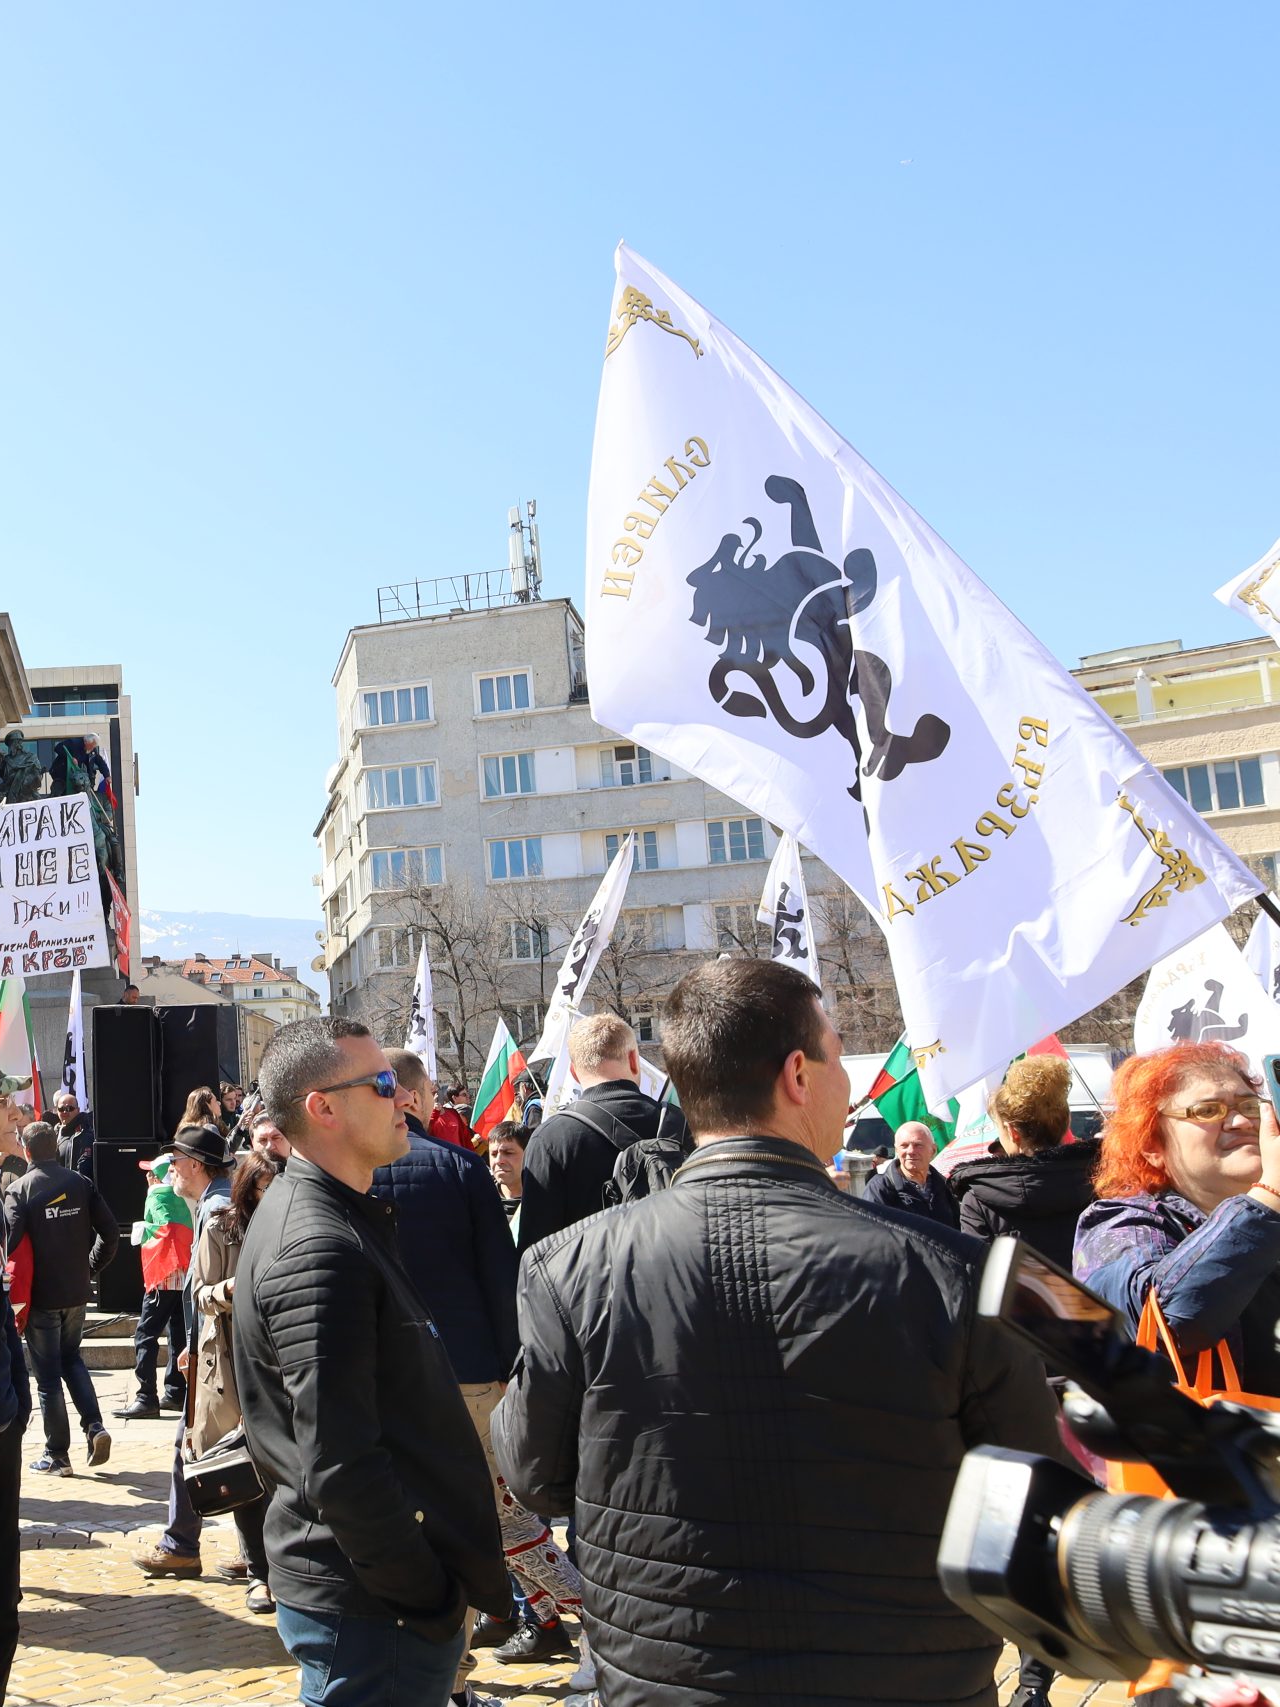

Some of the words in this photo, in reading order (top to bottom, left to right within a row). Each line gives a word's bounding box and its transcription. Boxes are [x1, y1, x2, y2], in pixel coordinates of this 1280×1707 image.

[15, 848, 57, 887] НЕ
[67, 843, 90, 884] Е
[45, 1207, 59, 1219] EY
